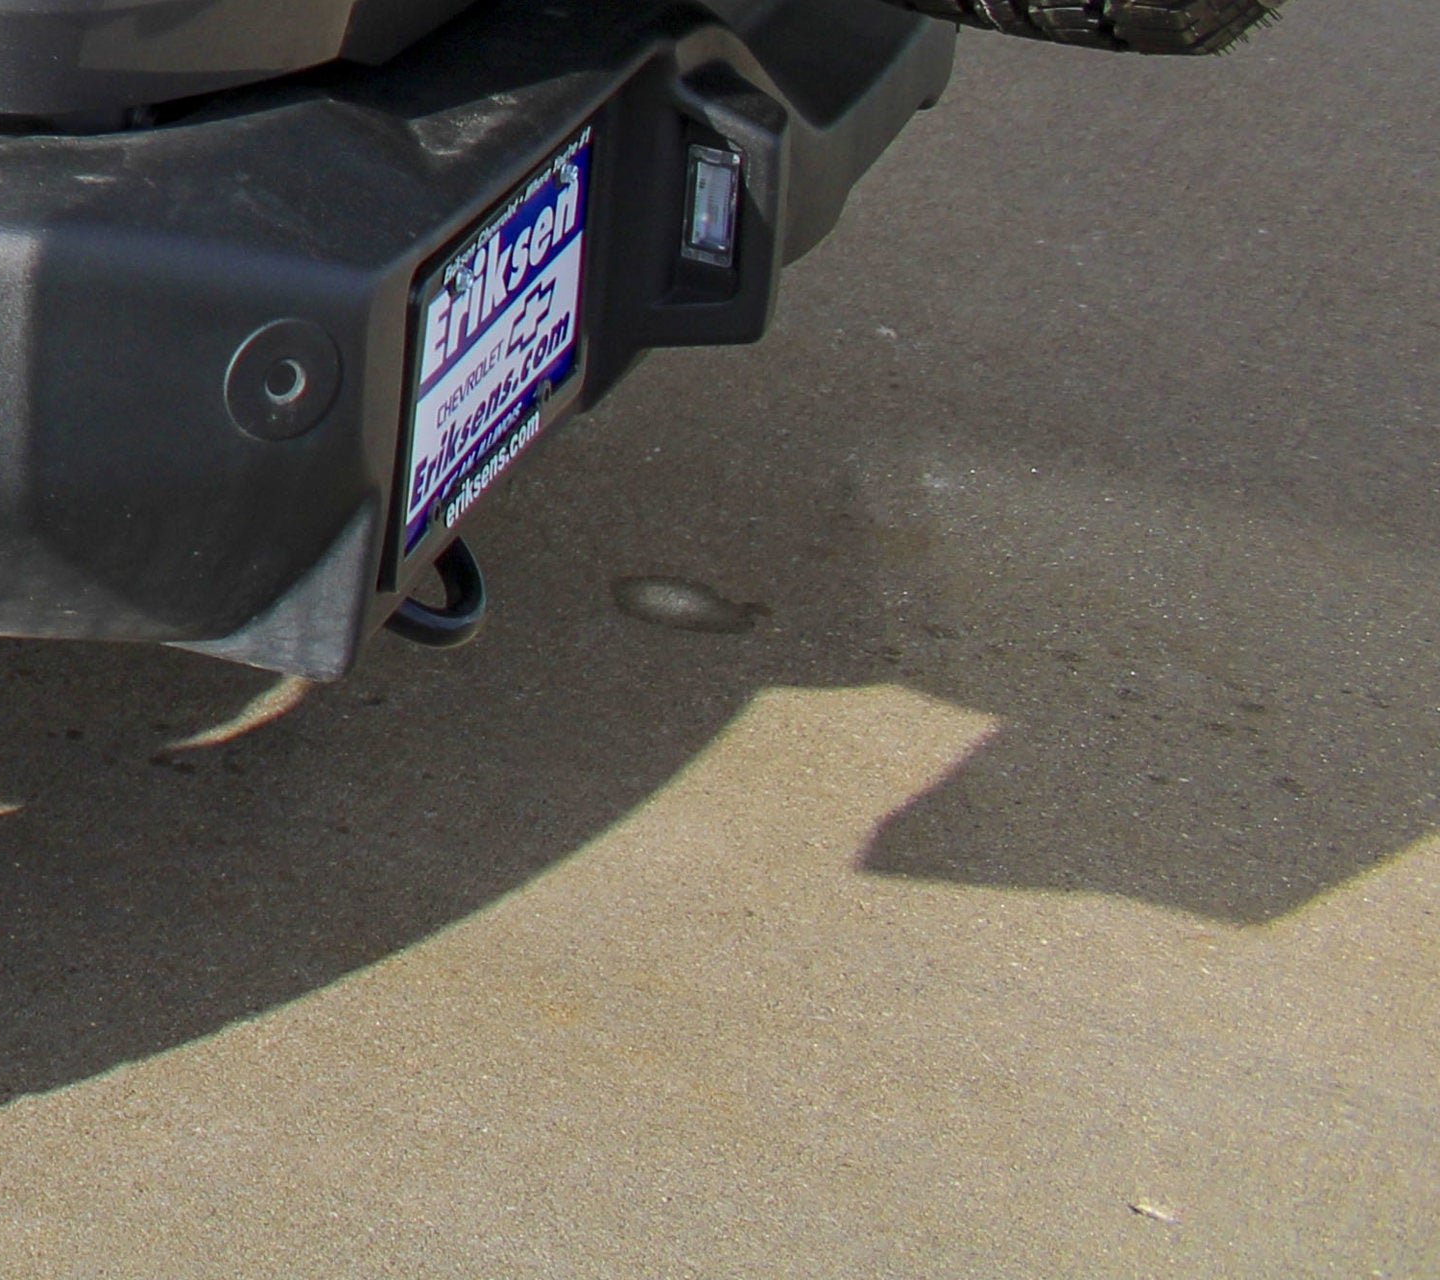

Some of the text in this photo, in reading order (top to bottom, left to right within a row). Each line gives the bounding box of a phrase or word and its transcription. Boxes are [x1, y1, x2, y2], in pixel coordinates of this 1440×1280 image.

[421, 182, 580, 384] Eriksen
[408, 310, 571, 513] Eriksens.com
[436, 339, 505, 429] CHEVROLET
[444, 410, 541, 528] eriksens.com
